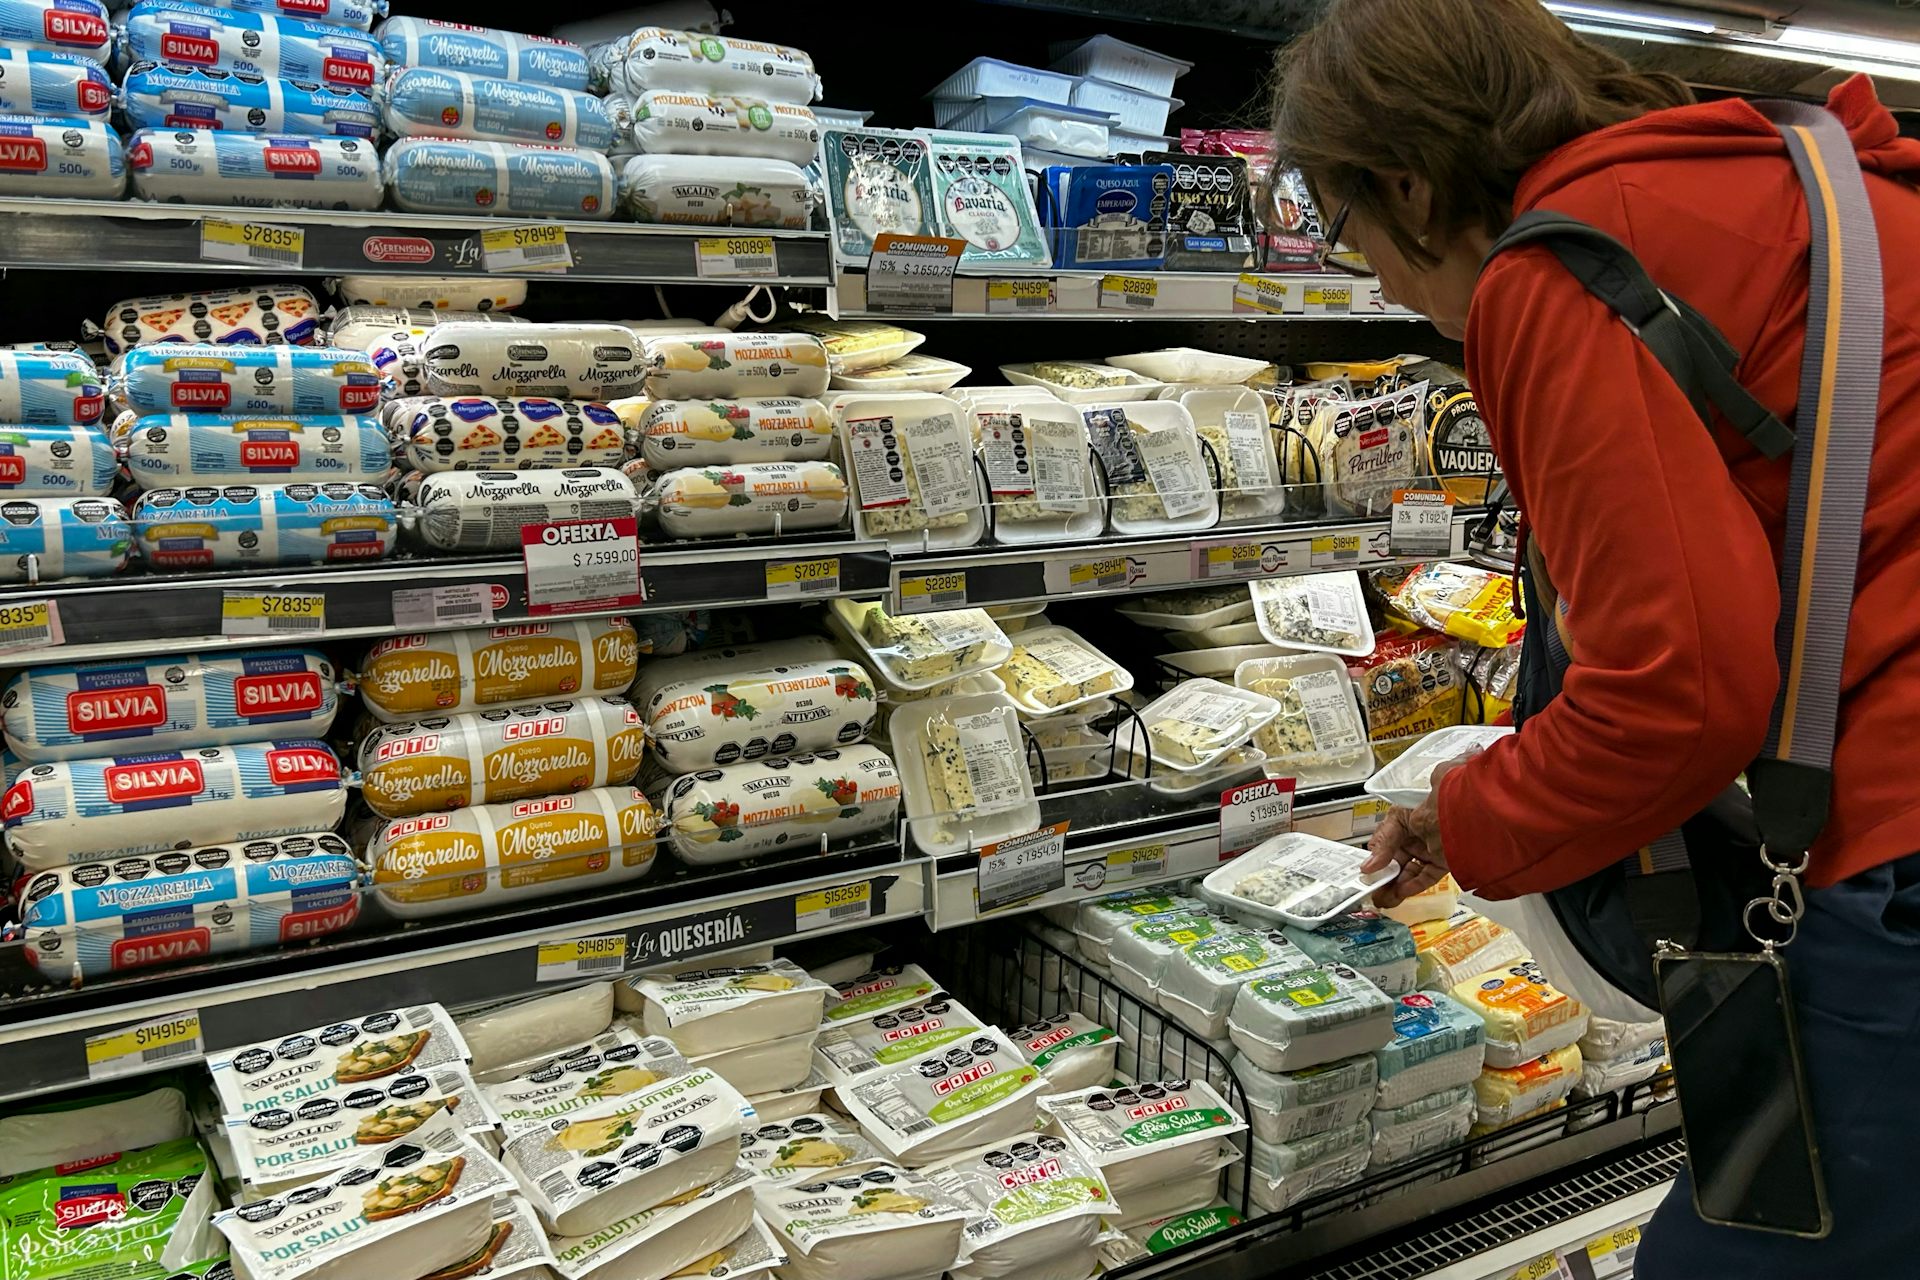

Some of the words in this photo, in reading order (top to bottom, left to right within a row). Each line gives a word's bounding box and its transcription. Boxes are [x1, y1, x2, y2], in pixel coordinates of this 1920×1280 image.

[166, 40, 213, 58] SILVIA
[429, 34, 500, 67] Mozzarella
[326, 64, 371, 82] SILVIA
[483, 80, 557, 108] Mozzarella
[267, 152, 316, 169] SILVIA
[406, 147, 487, 177] Mozzarella
[518, 154, 593, 183] Mozzarella
[675, 185, 717, 199] VACALIN
[1096, 179, 1118, 189] QUESO
[1119, 179, 1140, 188] AZUL
[954, 190, 1007, 212] Bavaria
[1096, 198, 1136, 209] EMPERADOR
[889, 241, 948, 253] COMUNIDAD
[878, 260, 896, 272] 15%
[903, 263, 910, 274] $
[913, 264, 952, 276] 3.650,75
[735, 347, 792, 362] MOZZARELLA
[492, 364, 567, 384] Mozzarella
[176, 388, 226, 402] SILVIA
[759, 417, 815, 432] MOZZARELLA
[245, 447, 295, 461] SILVIA
[1348, 448, 1403, 474] Parrillero
[466, 484, 540, 501] Mozzarella
[553, 481, 625, 499] Mozzarella
[1403, 493, 1446, 502] COMUNIDAD
[542, 524, 619, 546] OFERTA
[332, 547, 379, 557] SILVIA
[574, 553, 580, 567] $
[585, 548, 637, 567] 7.599,00
[478, 642, 578, 681] Mozzarella
[243, 681, 316, 705] SILVIA
[765, 676, 832, 694] MOZZARELLA
[78, 696, 159, 723] SILVIA
[504, 717, 565, 740] COTO
[377, 734, 440, 760] COTO
[518, 746, 542, 756] Queso
[115, 766, 195, 790] SILVIA
[489, 750, 591, 784] Mozzarella
[746, 777, 790, 794] VACALIN
[1231, 782, 1280, 806] OFERTA
[513, 797, 574, 817] COTO
[744, 804, 806, 828] MOZZARELLA
[1250, 810, 1256, 824] $
[1257, 803, 1289, 822] 1.399,90
[386, 816, 451, 841] COTO
[529, 821, 552, 830] Queso
[502, 820, 603, 859] Mozzarella
[997, 827, 1056, 850] COMUNIDAD
[383, 841, 479, 880] Mozzarella
[988, 857, 1006, 871] 15%
[1017, 853, 1023, 865] $
[1026, 843, 1060, 863] 1.954,91
[98, 879, 213, 906] MOZZARELLA
[1144, 921, 1164, 934] Por
[1164, 918, 1199, 932] Salut
[631, 932, 658, 965] La
[660, 915, 745, 958] QUESERÍA
[1194, 947, 1216, 960] Por
[1218, 939, 1249, 957] Salut
[121, 938, 201, 965] SILVIA
[841, 980, 896, 1002] COTO
[1262, 983, 1288, 995] Por
[1290, 973, 1320, 990] Salut
[1487, 991, 1501, 1003] Por
[1502, 985, 1524, 998] Salut
[884, 1018, 944, 1042] COTO
[1026, 1026, 1073, 1052] COTO
[567, 1059, 587, 1067] EXCESO
[606, 1050, 627, 1059] EXCESO
[249, 1062, 319, 1089] VACALIN
[273, 1078, 301, 1090] QUESO
[689, 1071, 715, 1090] POR
[934, 1060, 995, 1097] COTO
[512, 1086, 568, 1103] VACALIN
[532, 1095, 557, 1106] QUESO
[532, 1100, 582, 1119] SALUT
[583, 1092, 603, 1107] FIT
[637, 1082, 687, 1111] SALUT
[1126, 1094, 1188, 1121] COTO
[264, 1122, 337, 1145] VACALIN
[289, 1137, 319, 1147] QUESO
[255, 1152, 295, 1169] POR
[297, 1136, 358, 1160] SALUT
[998, 1158, 1062, 1189] COTO
[785, 1197, 843, 1211] VACALIN
[808, 1207, 832, 1216] QUESO
[261, 1204, 339, 1237] VACALIN
[292, 1221, 323, 1235] QUESO
[1162, 1227, 1187, 1246] Por
[1188, 1212, 1221, 1236] Salut
[259, 1243, 301, 1262] POR
[302, 1217, 369, 1248] SALUT
